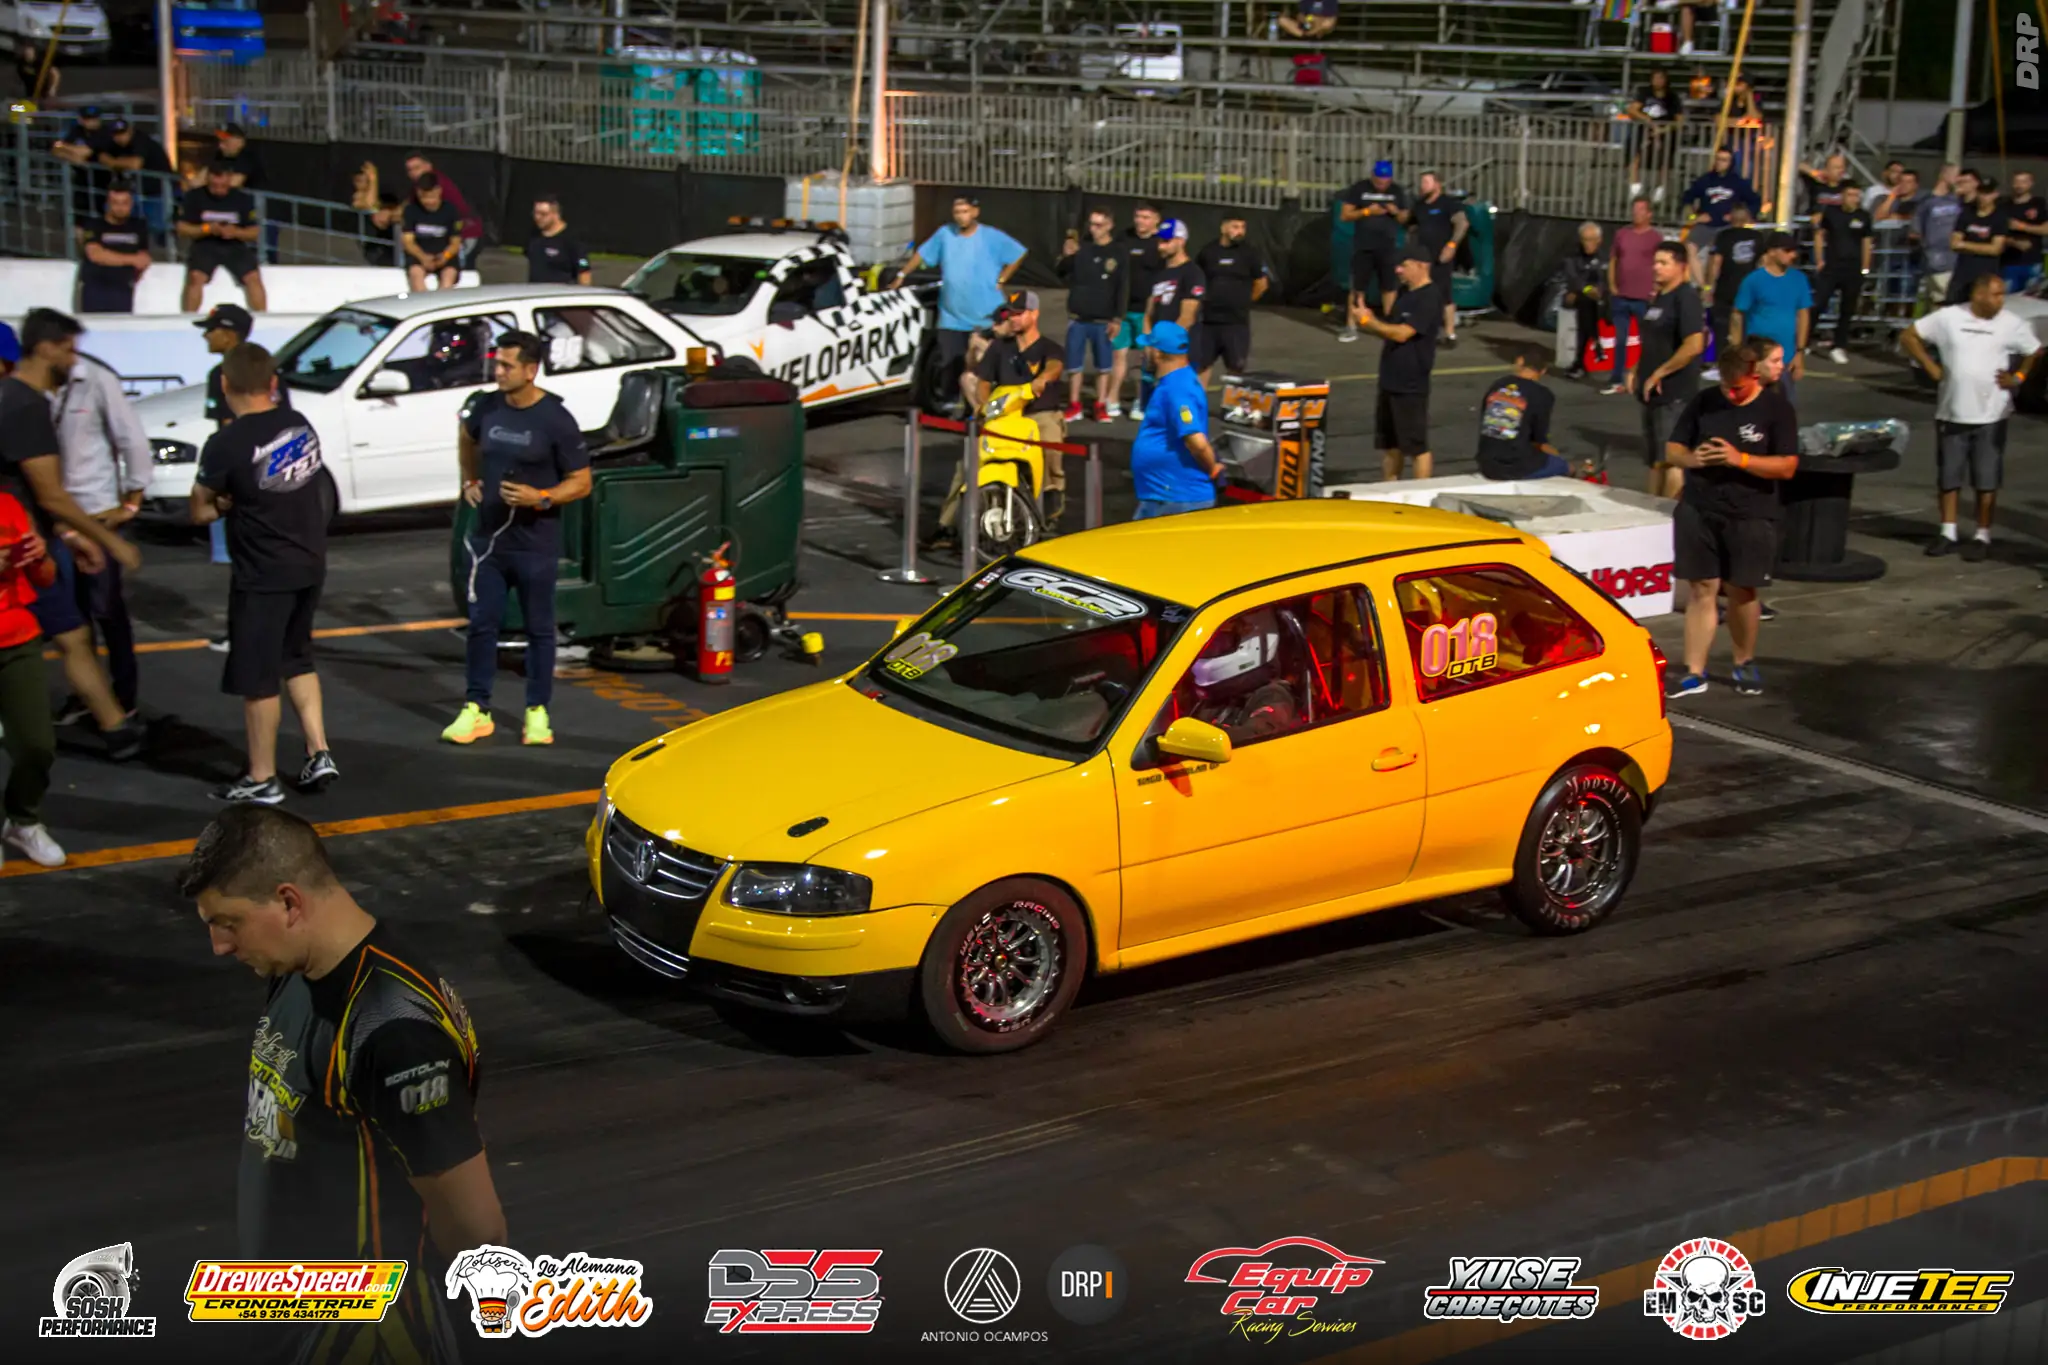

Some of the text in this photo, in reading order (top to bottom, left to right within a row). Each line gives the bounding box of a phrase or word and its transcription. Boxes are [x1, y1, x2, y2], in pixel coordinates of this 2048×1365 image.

[1002, 569, 1145, 620] GCR
[1421, 612, 1497, 677] 018
[1013, 900, 1061, 930] RACING
